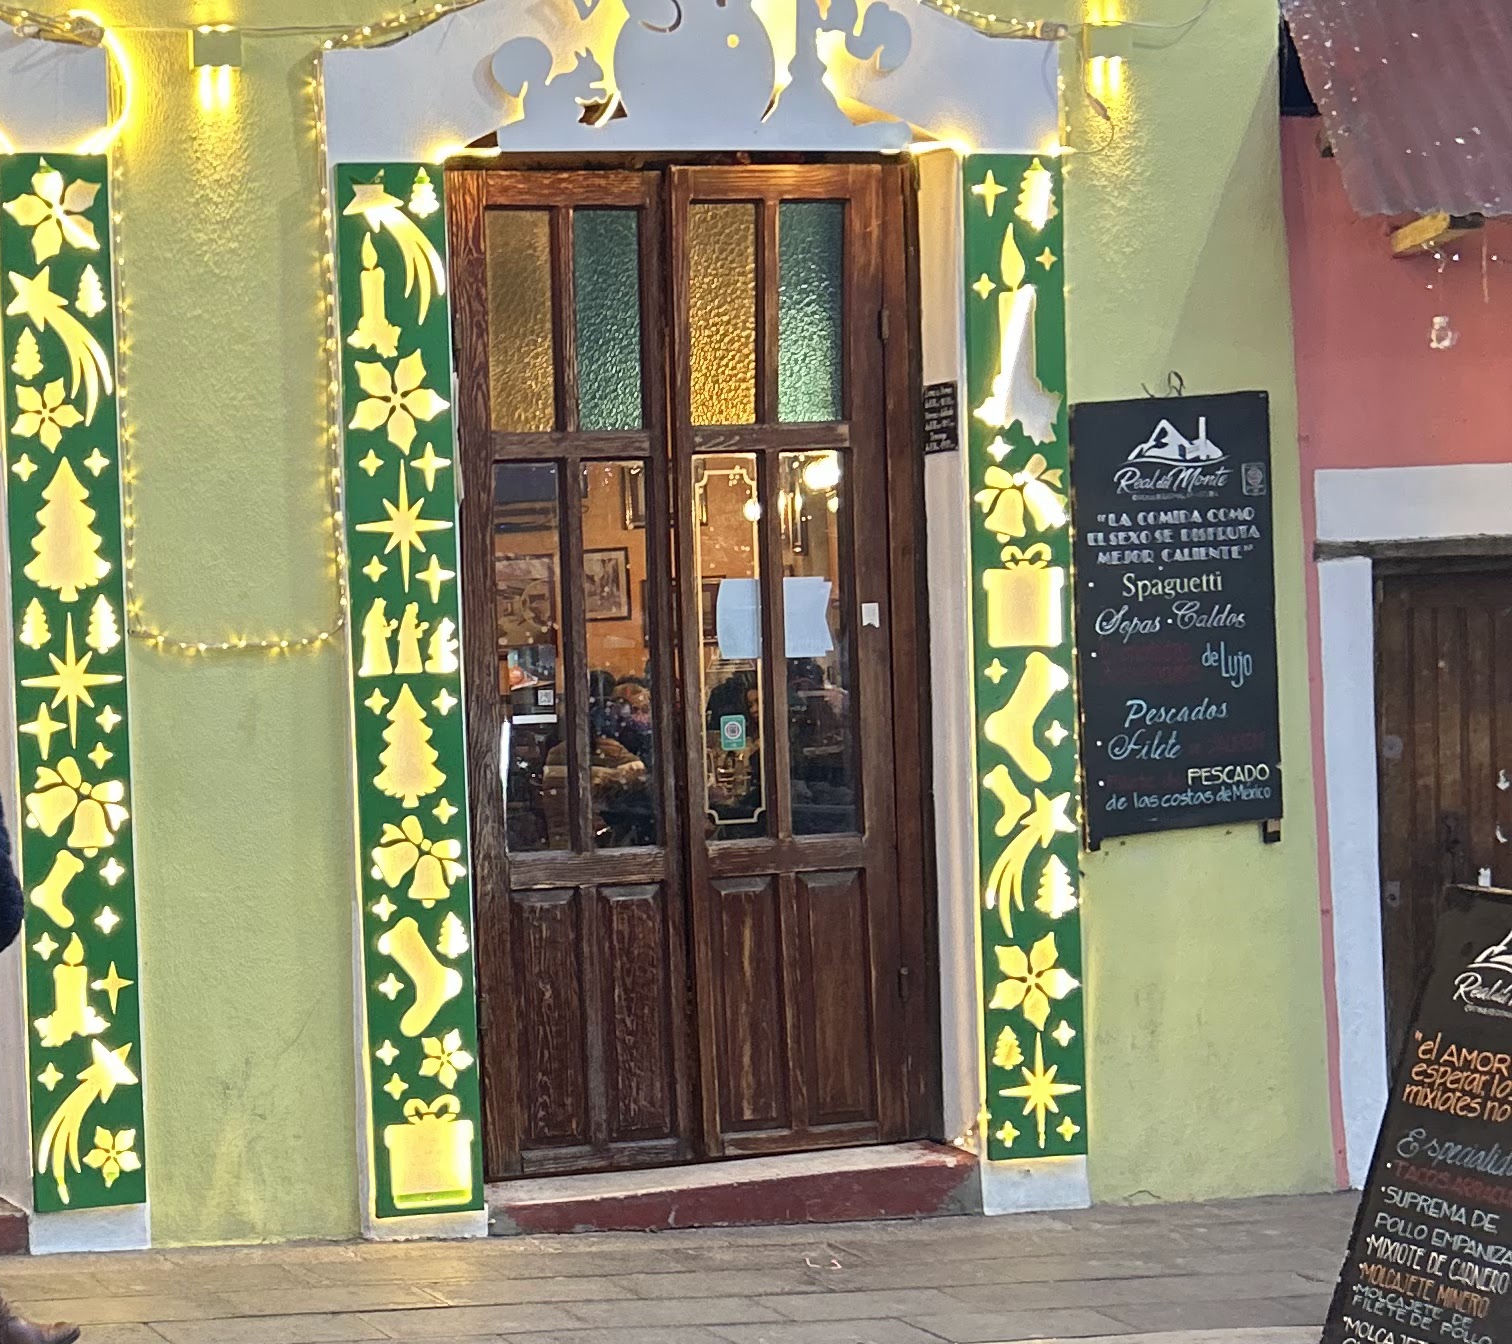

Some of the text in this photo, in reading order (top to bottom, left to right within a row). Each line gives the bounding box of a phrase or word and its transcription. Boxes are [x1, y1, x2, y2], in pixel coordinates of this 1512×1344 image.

[1113, 467, 1161, 495] Real
[1167, 466, 1234, 493] Monte
[1137, 509, 1203, 526] COMIDA
[1206, 507, 1256, 522] COMO
[1087, 525, 1260, 546] EL SEXO SE DISFRUTA
[1097, 548, 1155, 565] MEJOR
[1122, 571, 1223, 602] Spaguetti
[1095, 600, 1247, 643] Sopas Caldos
[1202, 642, 1219, 667] de
[1220, 641, 1253, 688] Lujo
[1124, 697, 1228, 728] Pescados
[1108, 729, 1183, 760] Filete
[1187, 763, 1270, 786] PESCADO
[1105, 793, 1128, 811] de
[1133, 791, 1160, 809] las
[1160, 787, 1214, 807] costas
[1216, 784, 1231, 802] de
[1439, 1044, 1511, 1076] AMOR
[1402, 1083, 1511, 1123] mixiotes no
[1490, 1073, 1512, 1102] lo
[1384, 1186, 1500, 1234] SUPREMA DE
[1374, 1212, 1429, 1240] POLLO
[1366, 1234, 1510, 1294] MIXIOTE DE CARNERO
[1355, 1283, 1474, 1329] MOLCAJETE DE
[1360, 1262, 1490, 1319] MOLCAJETE MINERO
[1351, 1294, 1407, 1323] FILETE
[1409, 1313, 1433, 1331] DE
